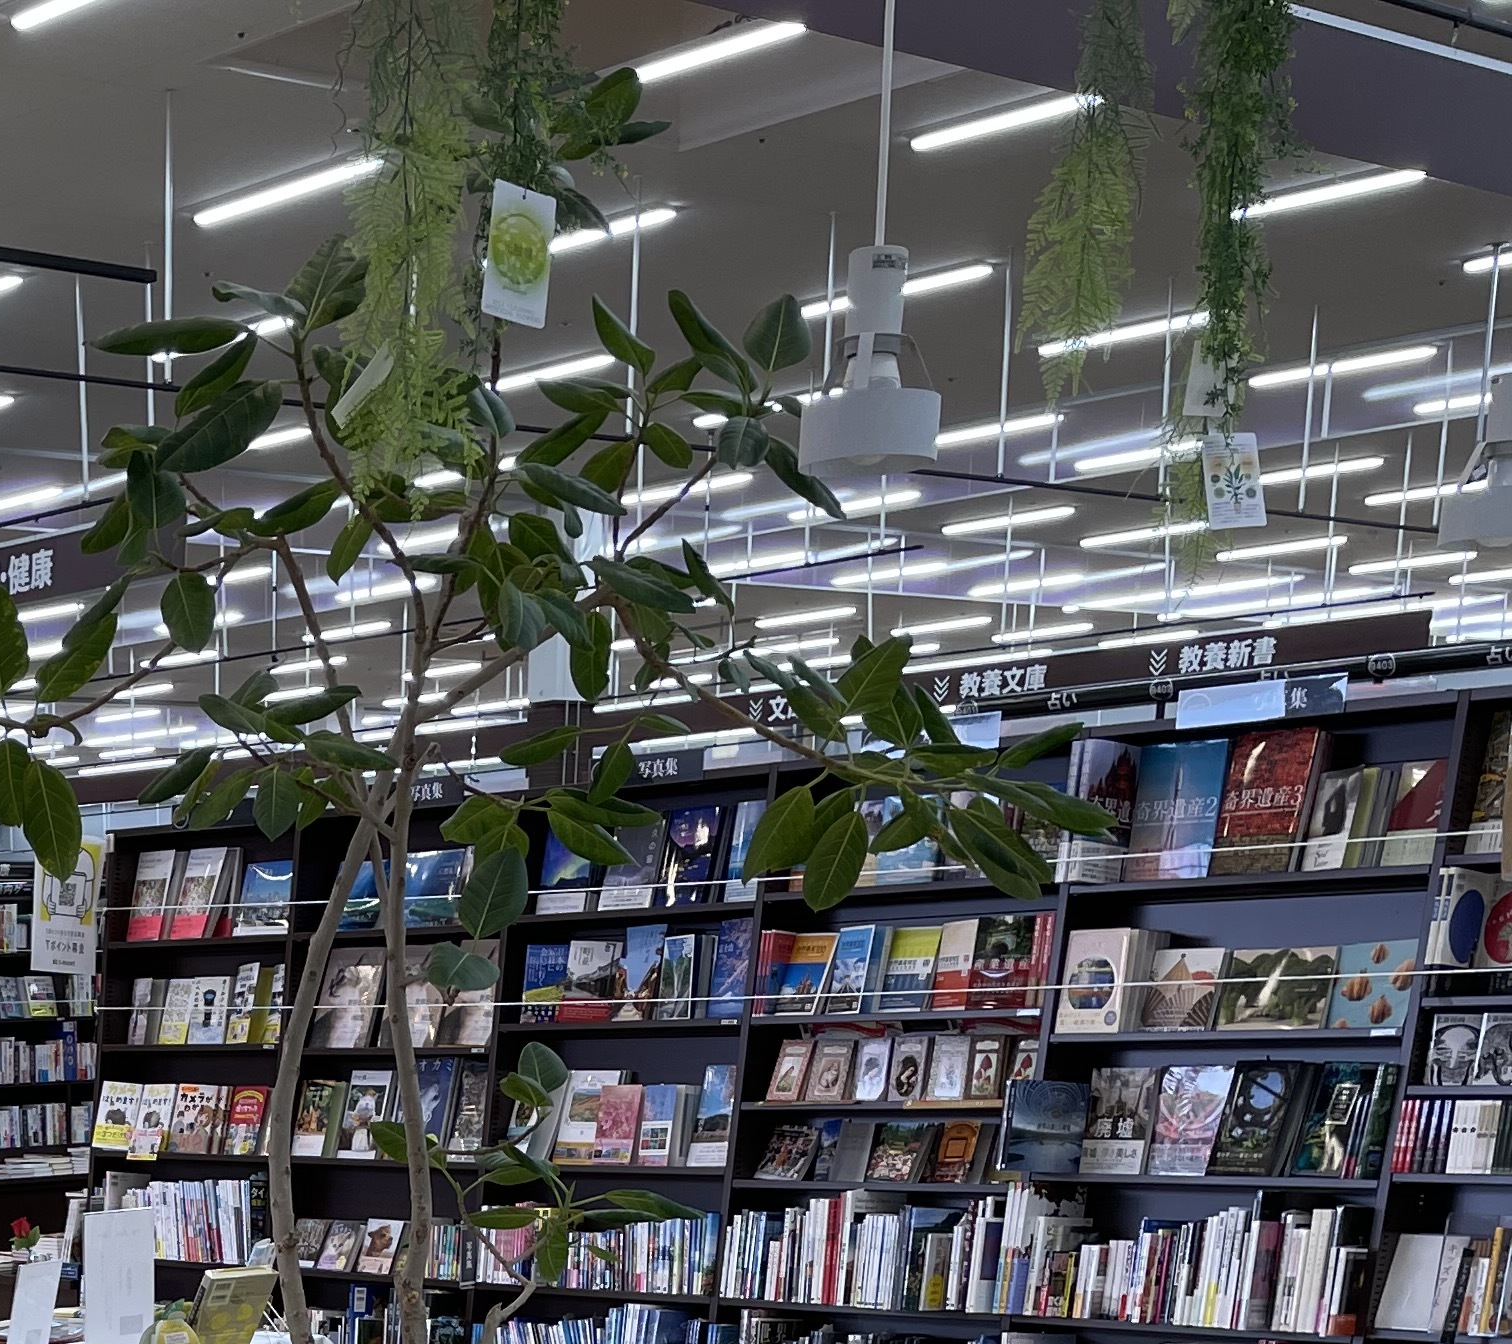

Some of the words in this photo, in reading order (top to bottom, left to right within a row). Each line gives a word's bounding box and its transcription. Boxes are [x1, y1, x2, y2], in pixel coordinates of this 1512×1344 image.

[1178, 636, 1278, 674] 教養新書
[958, 664, 1048, 699] 教養文庫
[1048, 692, 1078, 710] 占い
[639, 757, 679, 778] 写真集
